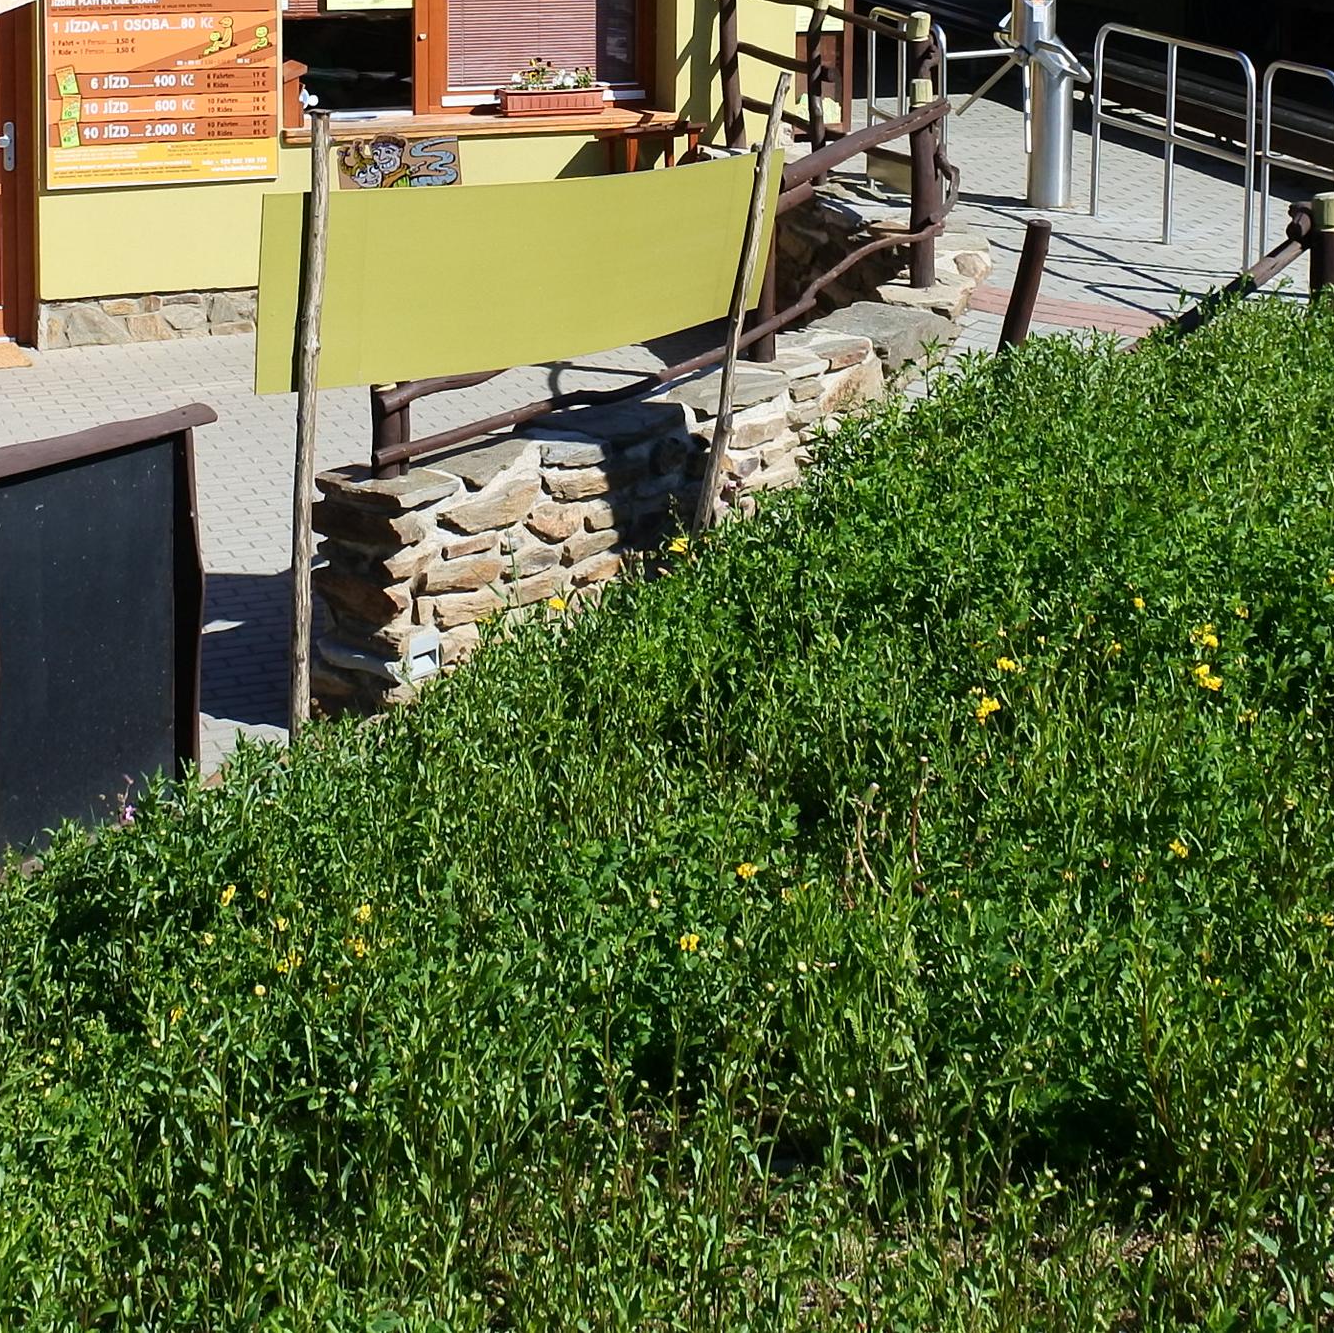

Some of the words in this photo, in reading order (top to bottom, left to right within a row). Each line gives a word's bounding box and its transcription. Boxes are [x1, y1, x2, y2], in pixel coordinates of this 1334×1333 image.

[52, 22, 58, 33] 1
[64, 19, 99, 33] JÍZDA
[111, 20, 118, 31] 1
[123, 18, 169, 31] OSOBA
[181, 17, 195, 29] 80
[200, 17, 214, 29] Kč
[90, 77, 98, 89] 6
[103, 75, 129, 89] JÍZD
[153, 74, 176, 87] 400
[181, 74, 194, 86] Kč
[84, 102, 98, 115] 10
[103, 99, 129, 114] JÍZD
[182, 98, 195, 111] Kč
[103, 124, 129, 138] JÍZD
[145, 123, 177, 137] 2.000
[182, 122, 196, 135] Kč
